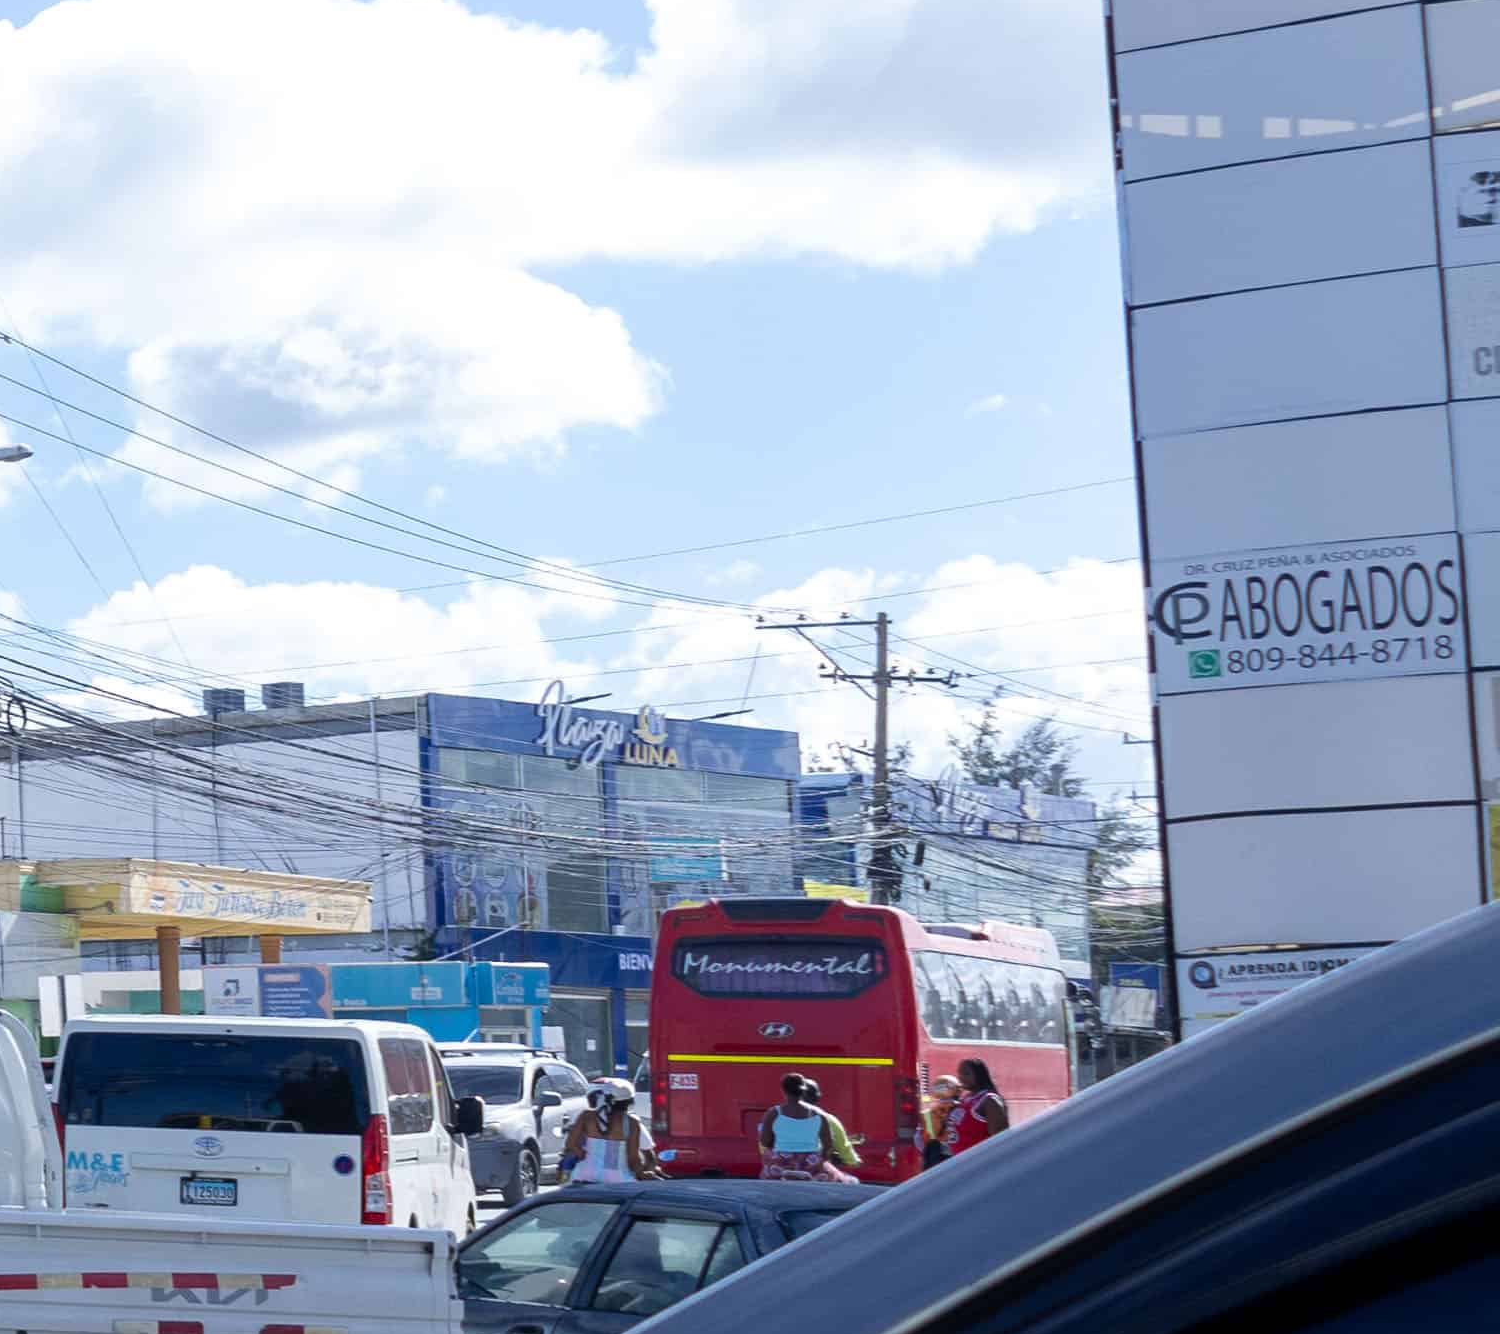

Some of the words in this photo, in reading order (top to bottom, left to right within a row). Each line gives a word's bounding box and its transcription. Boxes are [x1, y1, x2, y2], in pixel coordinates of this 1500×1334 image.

[1212, 559, 1253, 572] CRUZ
[1258, 554, 1299, 568] PEÑA
[1304, 554, 1315, 565] &
[1320, 545, 1416, 564] ASOCIADOS
[1220, 559, 1458, 641] ABOGADOS
[1227, 634, 1454, 674] 809-844-8718
[625, 742, 679, 765] LUNA
[683, 951, 873, 975] Monumental
